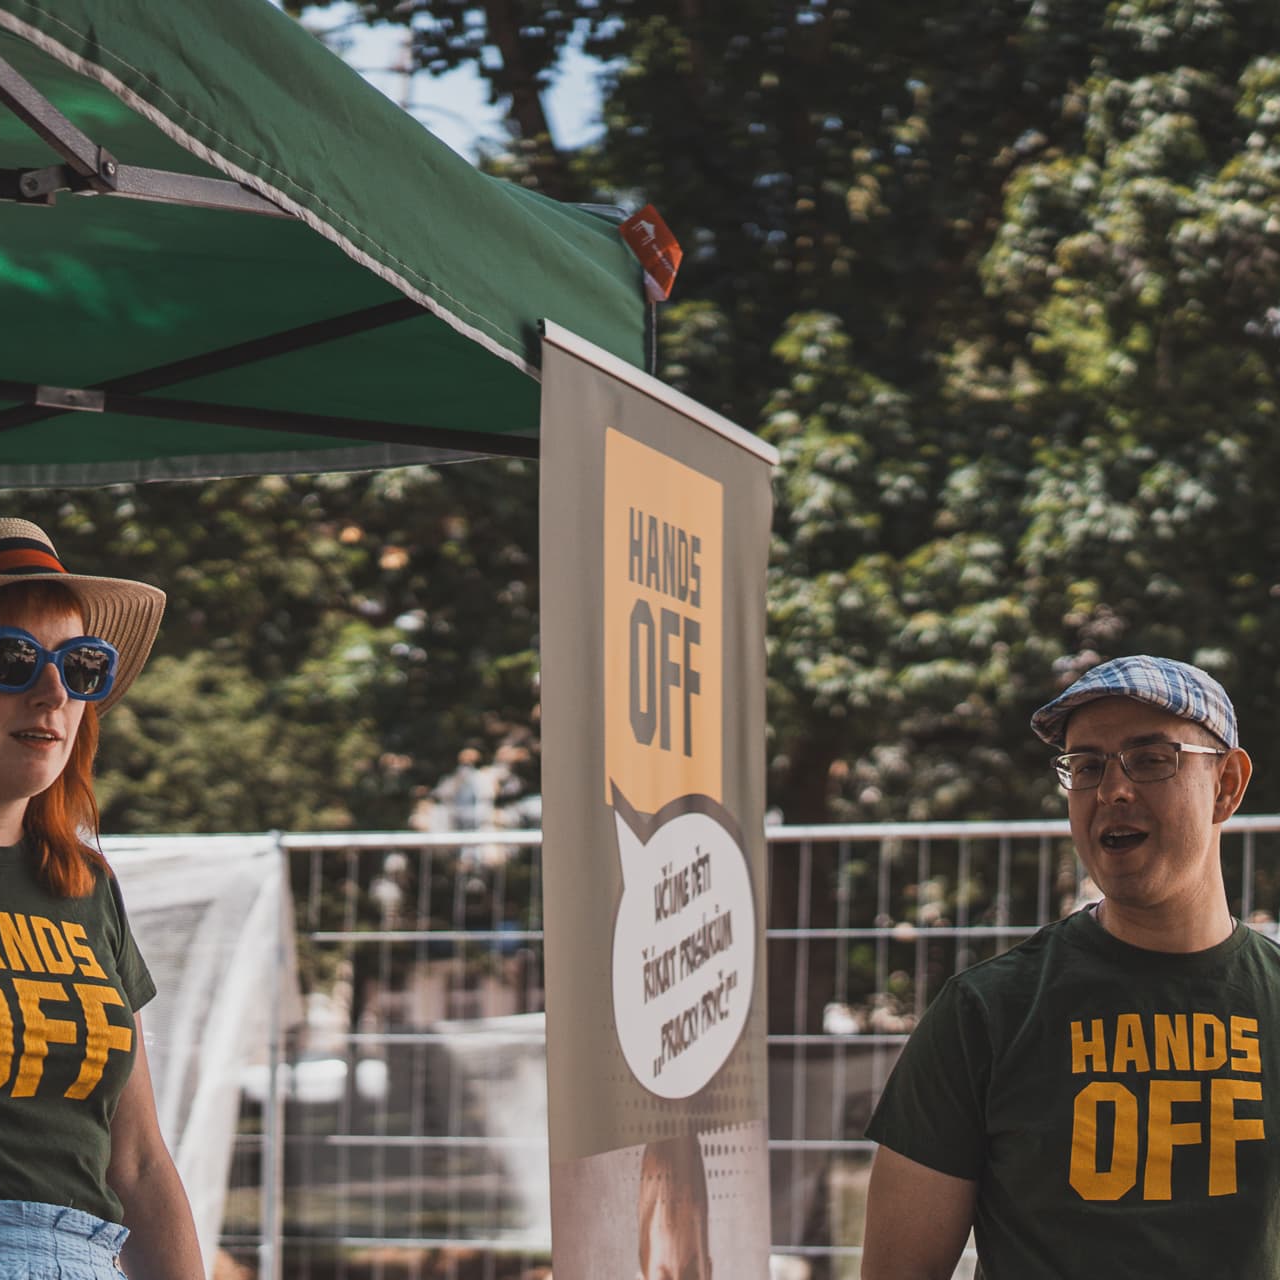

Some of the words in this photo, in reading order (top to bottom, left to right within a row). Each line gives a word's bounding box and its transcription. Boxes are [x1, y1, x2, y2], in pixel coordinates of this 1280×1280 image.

[628, 506, 702, 608] HANDS
[628, 598, 702, 758] OFF
[654, 861, 689, 923] UČÍME
[691, 845, 711, 901] DĚTI
[642, 945, 677, 1005] ŘÍKAT
[1070, 1013, 1262, 1074] HANDS
[1068, 1078, 1266, 1201] OFF
